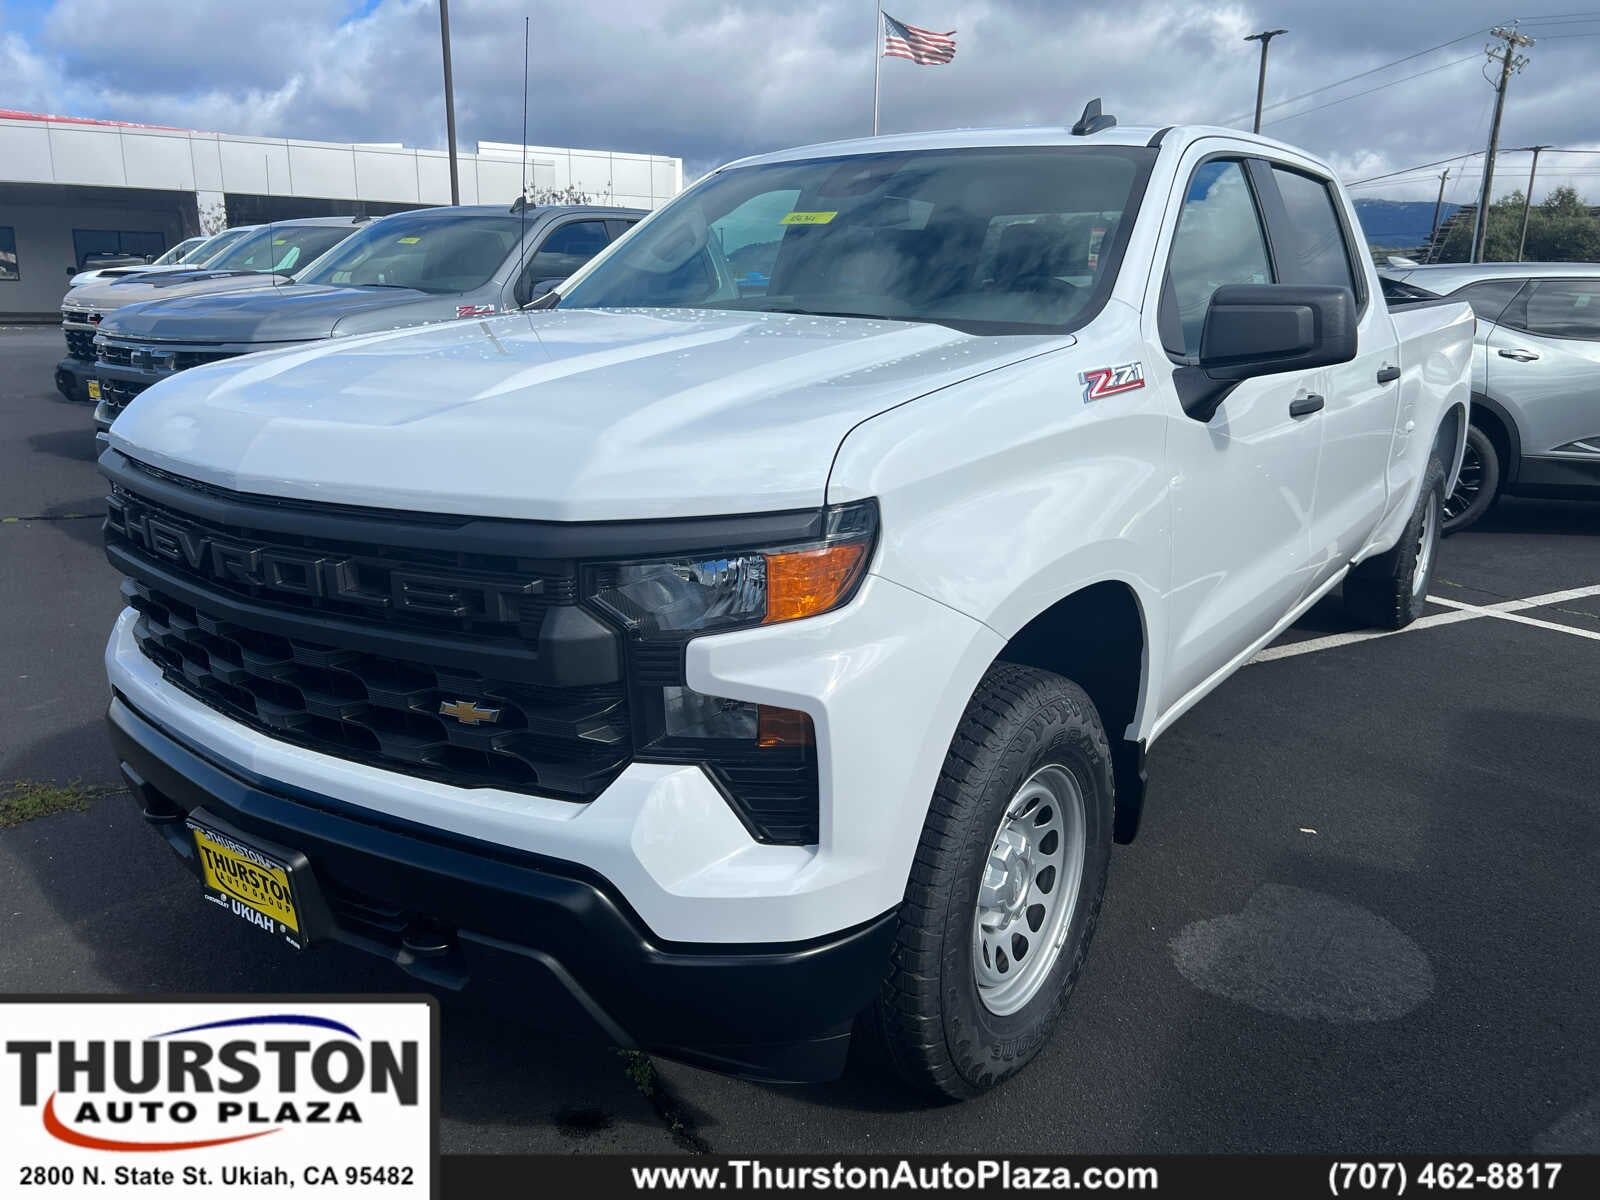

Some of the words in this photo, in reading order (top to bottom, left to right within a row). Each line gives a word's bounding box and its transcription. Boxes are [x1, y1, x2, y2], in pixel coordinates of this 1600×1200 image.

[1078, 361, 1146, 404] Z71
[104, 494, 546, 622] CHEVROLET
[220, 871, 249, 893] AUTO
[252, 888, 292, 914] GROUP
[232, 900, 275, 934] UKIAH
